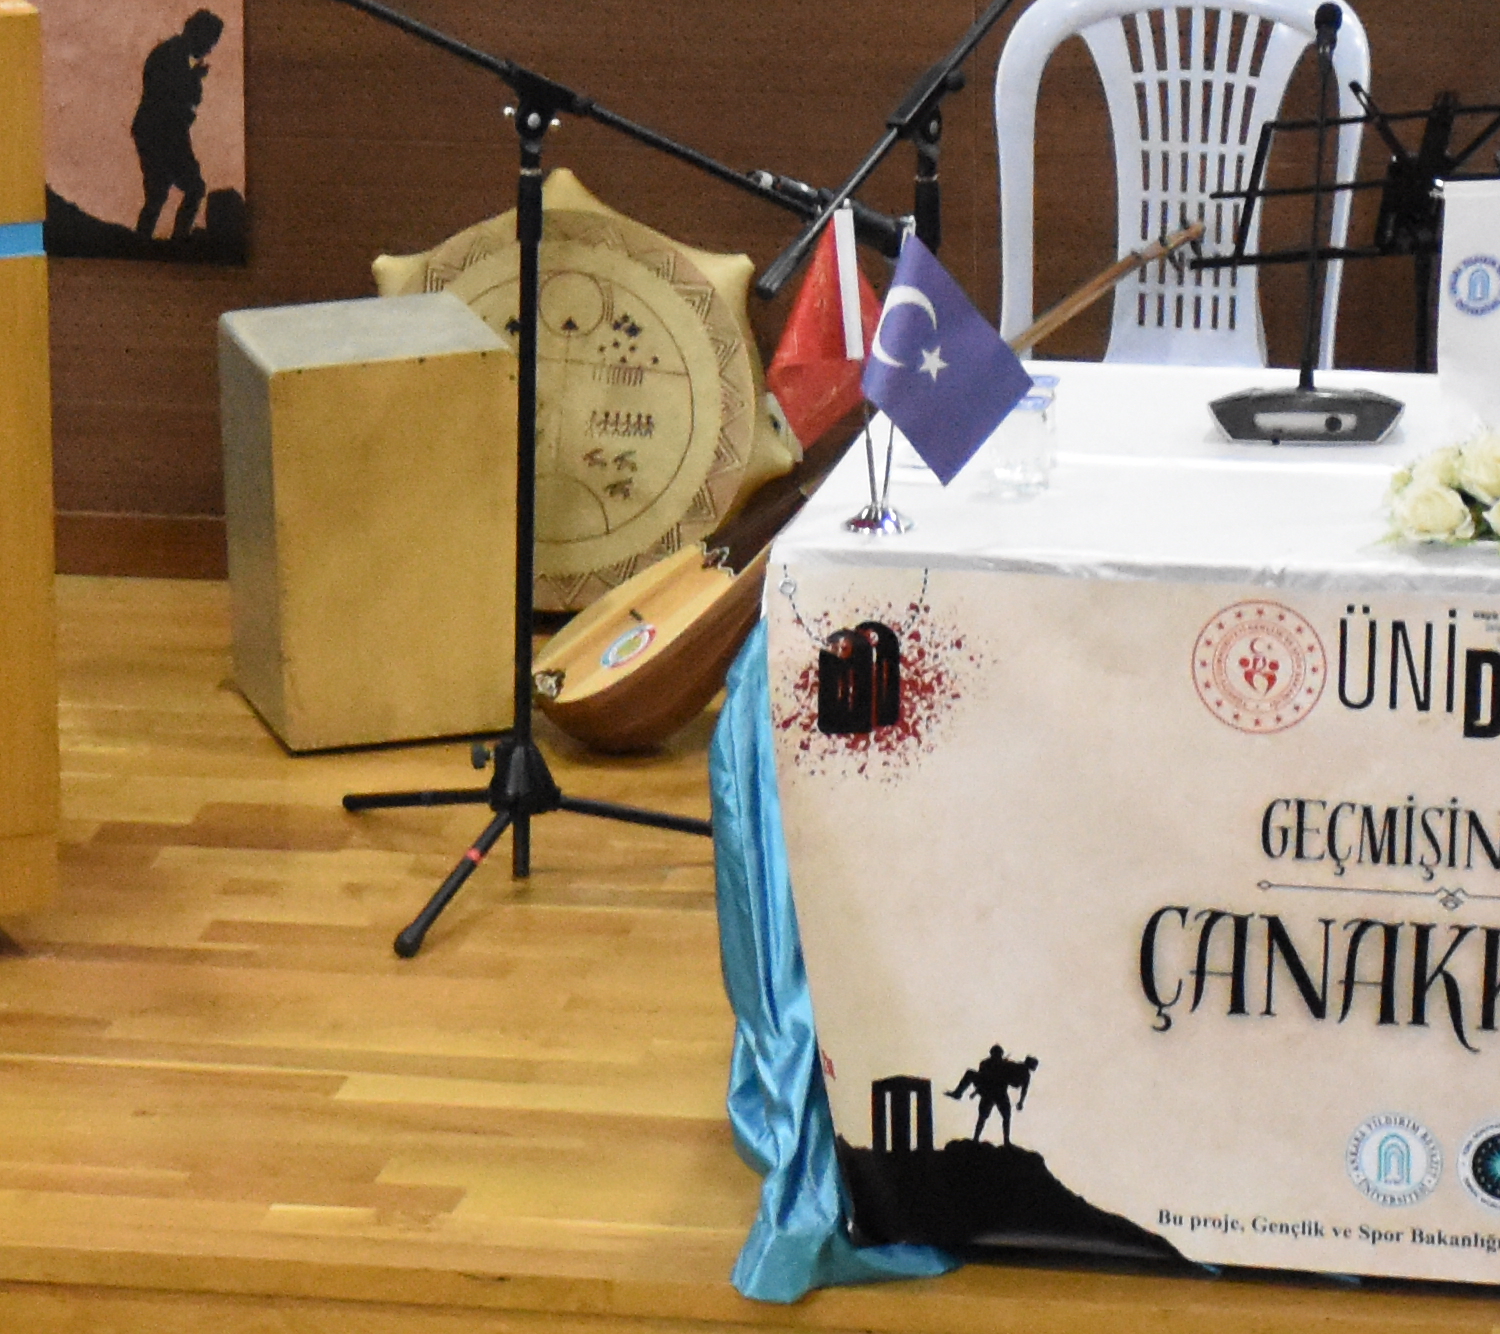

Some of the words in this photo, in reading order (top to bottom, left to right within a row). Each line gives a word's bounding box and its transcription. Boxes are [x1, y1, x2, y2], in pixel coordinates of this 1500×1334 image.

[1158, 1208, 1184, 1227] Bu
[1190, 1213, 1245, 1234] proje,
[1251, 1214, 1325, 1240] Gençlik
[1331, 1225, 1352, 1240] ve
[1357, 1223, 1404, 1246] Spor
